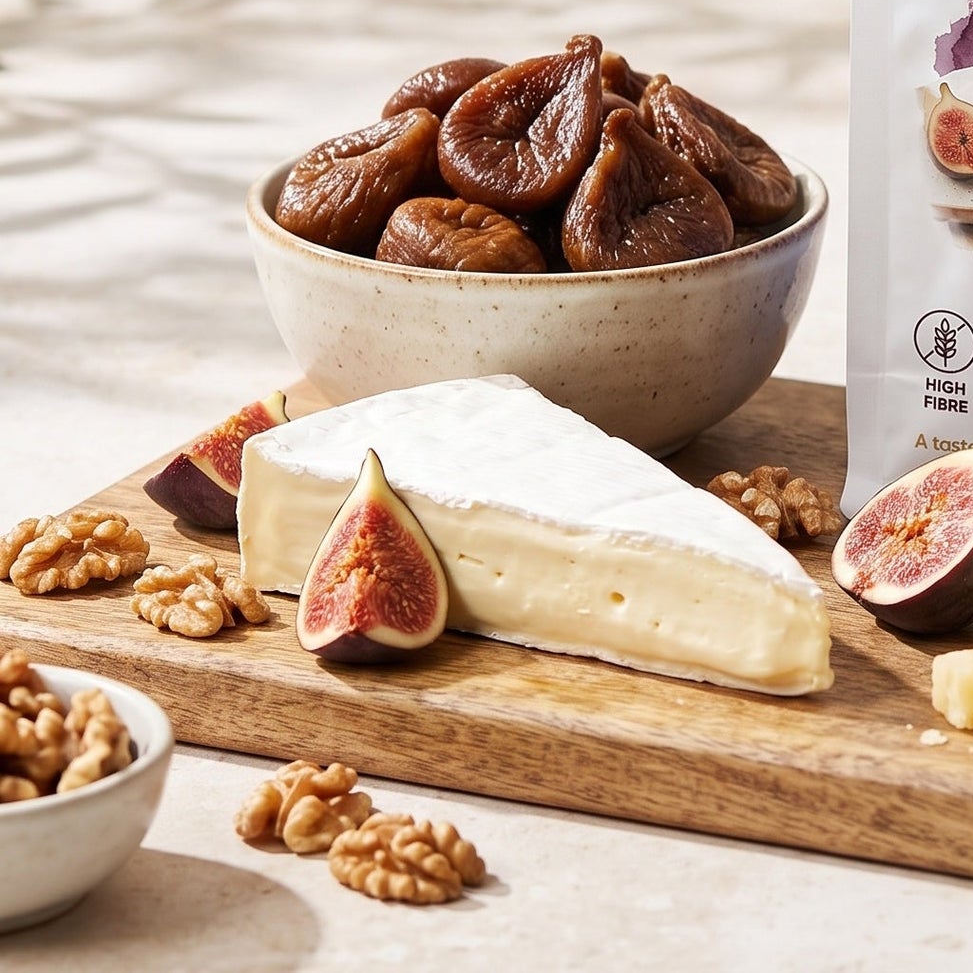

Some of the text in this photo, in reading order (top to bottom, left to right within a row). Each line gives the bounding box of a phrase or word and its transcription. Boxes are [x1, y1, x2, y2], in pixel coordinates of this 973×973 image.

[926, 377, 966, 396] HIGH
[924, 395, 969, 413] FIBRE
[915, 433, 928, 449] A
